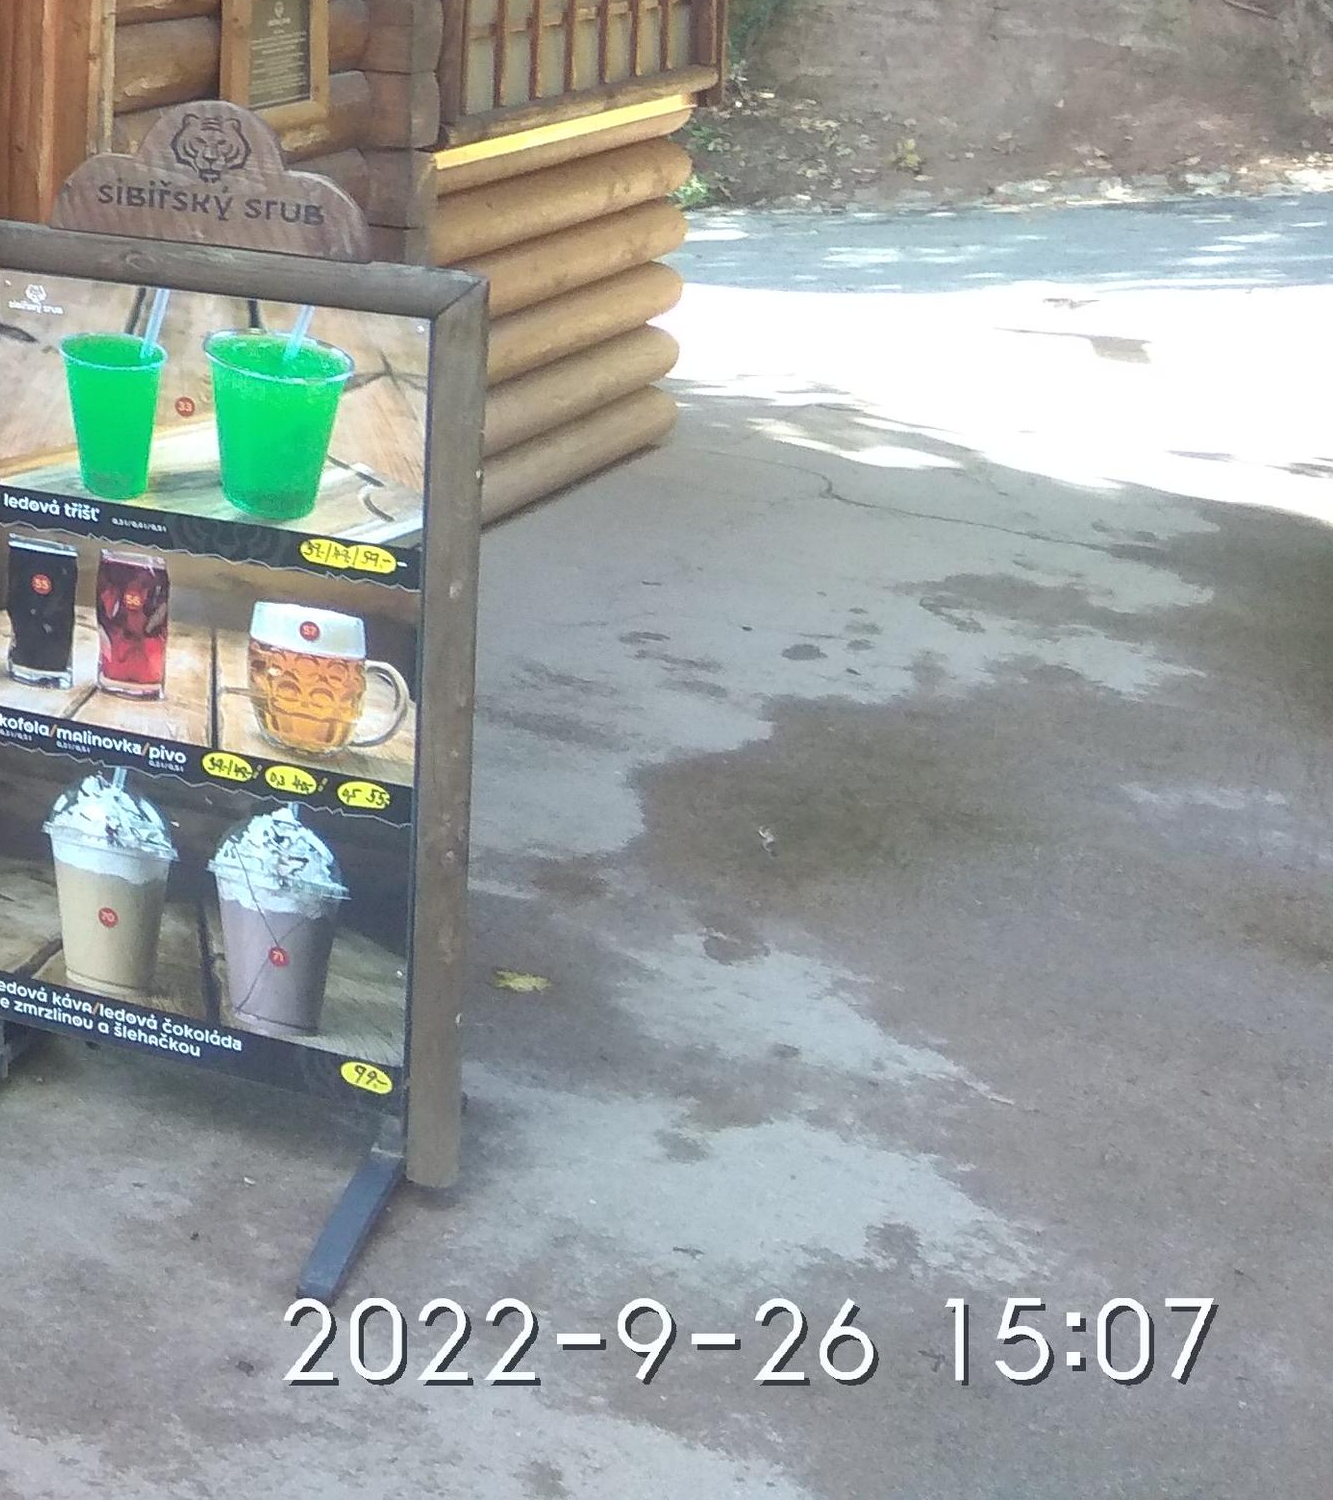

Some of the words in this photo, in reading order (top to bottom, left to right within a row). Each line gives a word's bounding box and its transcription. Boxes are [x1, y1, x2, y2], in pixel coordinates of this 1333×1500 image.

[3, 492, 60, 516] ledová
[13, 1001, 94, 1030] zmrzlinou
[98, 1021, 110, 1034] a
[113, 1020, 202, 1057] šlehačkou
[161, 1017, 243, 1052] čokoláda
